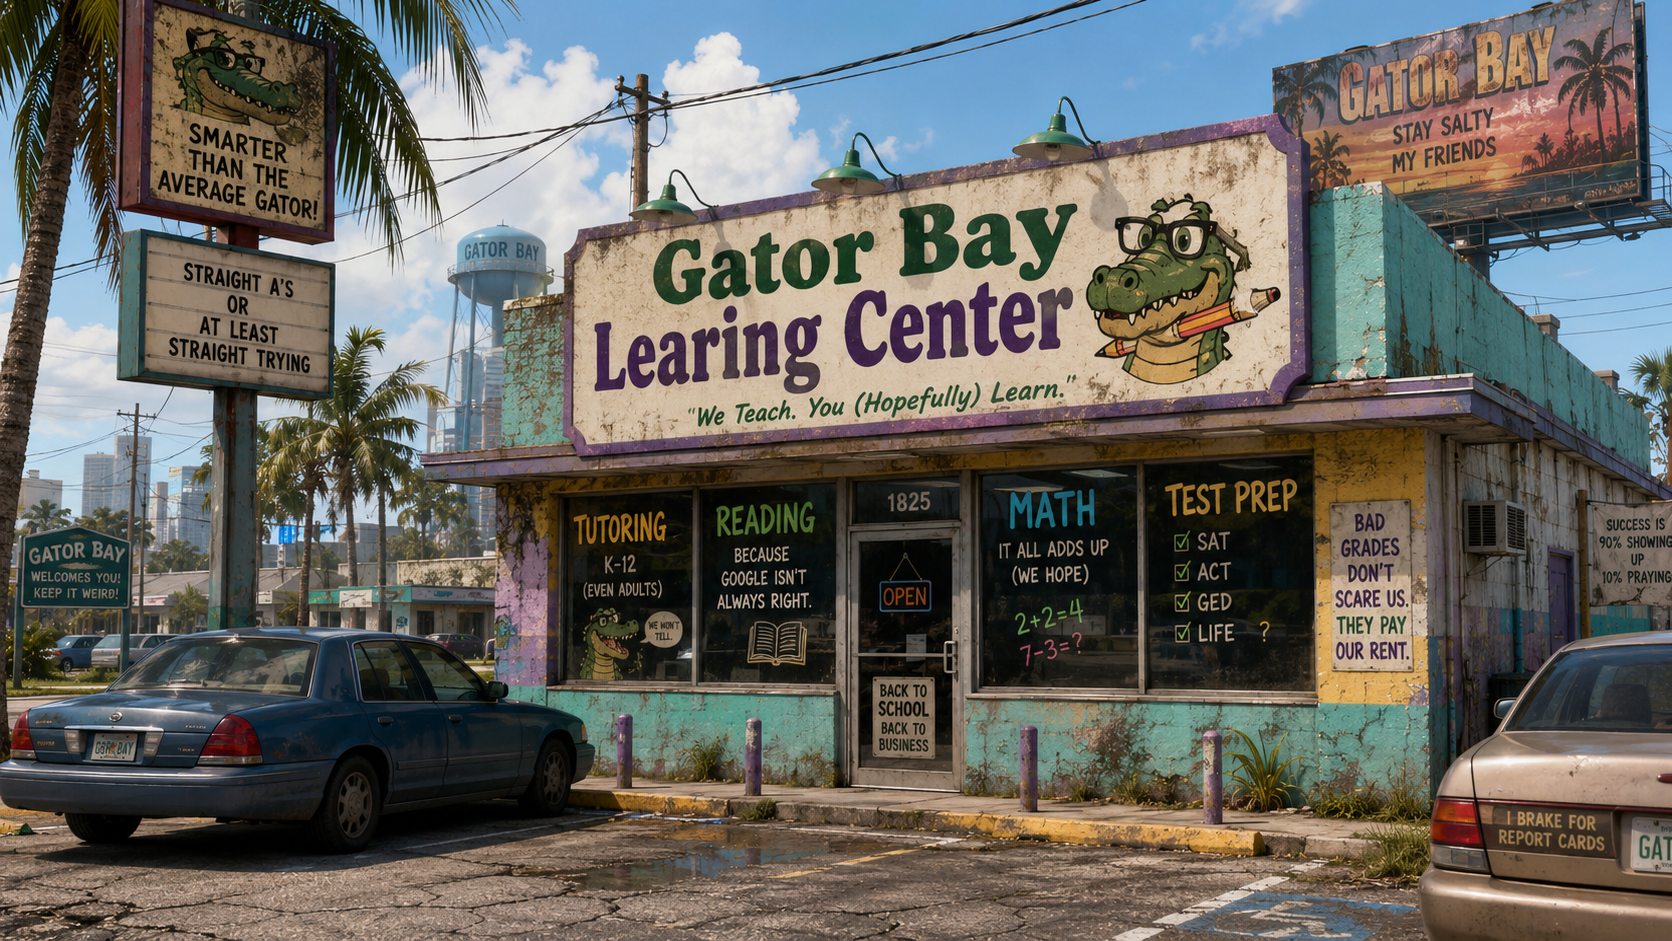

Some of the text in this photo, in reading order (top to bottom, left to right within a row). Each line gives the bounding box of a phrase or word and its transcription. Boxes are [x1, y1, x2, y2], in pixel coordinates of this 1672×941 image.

[1338, 26, 1555, 125] GATOR BAY
[1393, 107, 1494, 145] STAY SALTY
[189, 123, 287, 163] SMARTER
[1392, 136, 1497, 174] MY FRIENDS
[188, 149, 288, 189] THAN THE
[158, 170, 318, 220] AVERAGE GATOR!
[465, 241, 539, 261] GATOR BAY
[653, 203, 1077, 305] Gator Bay
[183, 263, 294, 298] STRAIGHT A'S
[227, 295, 248, 315] OR
[200, 316, 278, 344] AT LEAST
[594, 281, 1073, 394] Learing Center
[168, 338, 310, 373] STRAIGHT TRYING
[688, 374, 1077, 427] "We Teach. You (Hopefully) Learn."
[887, 491, 930, 512] 1825
[1165, 478, 1298, 517] TEST PREP
[1009, 489, 1095, 529] MATH
[573, 511, 666, 545] TUTORING
[716, 502, 815, 537] READING
[1354, 513, 1385, 532] BAD
[1607, 518, 1665, 531] SUCCESS IS
[999, 539, 1109, 559] IT ALL ADDS UP
[1198, 531, 1231, 551] SAT
[1341, 537, 1400, 557] GRADES
[1599, 535, 1672, 548] 90% SHOWING
[29, 541, 125, 565] GATOR BAY
[734, 546, 790, 564] BECAUSE
[1631, 554, 1644, 566] UP
[604, 555, 636, 574] K-12
[1198, 562, 1232, 581] ACT
[1348, 563, 1395, 583] DON'T
[31, 571, 120, 583] WELCOMES YOU!
[721, 569, 807, 587] GOOGLE ISN'T
[1012, 564, 1089, 586] (WE HOPE)
[1603, 571, 1671, 583] 10% PRAYING
[34, 587, 118, 599] KEEP IT WEIRD!
[583, 580, 663, 600] (EVEN ADULTS)
[883, 587, 926, 606] OPEN
[1335, 589, 1408, 608] SCARE US.
[717, 592, 812, 610] ALWAYS RIGHT.
[1198, 593, 1232, 611] GED
[648, 621, 658, 629] WE
[1015, 598, 1084, 636] 2+2=4
[1336, 616, 1407, 635] THEY PAY
[655, 632, 672, 640] TELL.
[1198, 621, 1270, 642] LIFE ?
[1019, 631, 1083, 666] 7-3=?
[1335, 641, 1409, 660] OUR RENT.
[880, 684, 927, 698] BACK TO
[878, 701, 929, 717] SCHOOL
[881, 722, 926, 736] BACK TO
[117, 742, 134, 755] BAY
[879, 738, 929, 752] BUSINESS
[1507, 811, 1596, 831] I BRAKE FOR
[1499, 830, 1605, 851] REPORT CARDS
[1639, 835, 1672, 860] GAT
